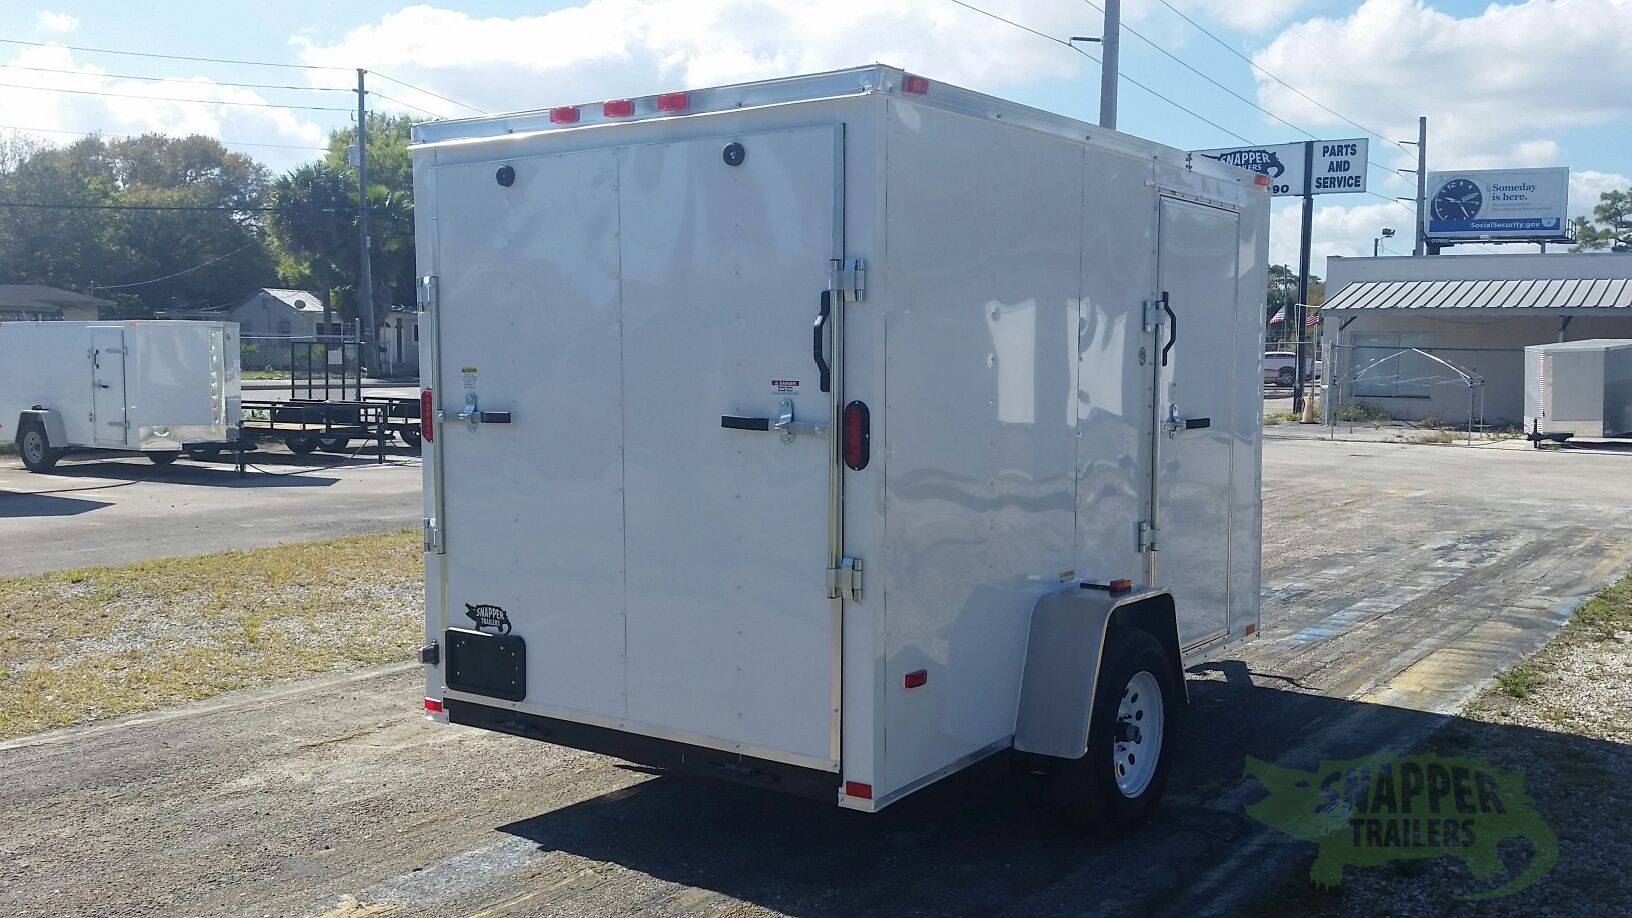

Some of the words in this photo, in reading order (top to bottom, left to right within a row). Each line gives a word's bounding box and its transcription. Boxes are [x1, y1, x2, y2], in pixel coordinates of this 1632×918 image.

[1322, 143, 1357, 157] PARTS
[1328, 160, 1350, 173] AND
[1315, 175, 1361, 189] SERVICE
[1492, 183, 1537, 192] Someday
[1492, 193, 1500, 201] is
[1502, 192, 1528, 201] here.
[1470, 221, 1541, 230] SocialSecurity.gov
[476, 607, 505, 620] SNAPPER
[481, 618, 501, 626] TRAILERS
